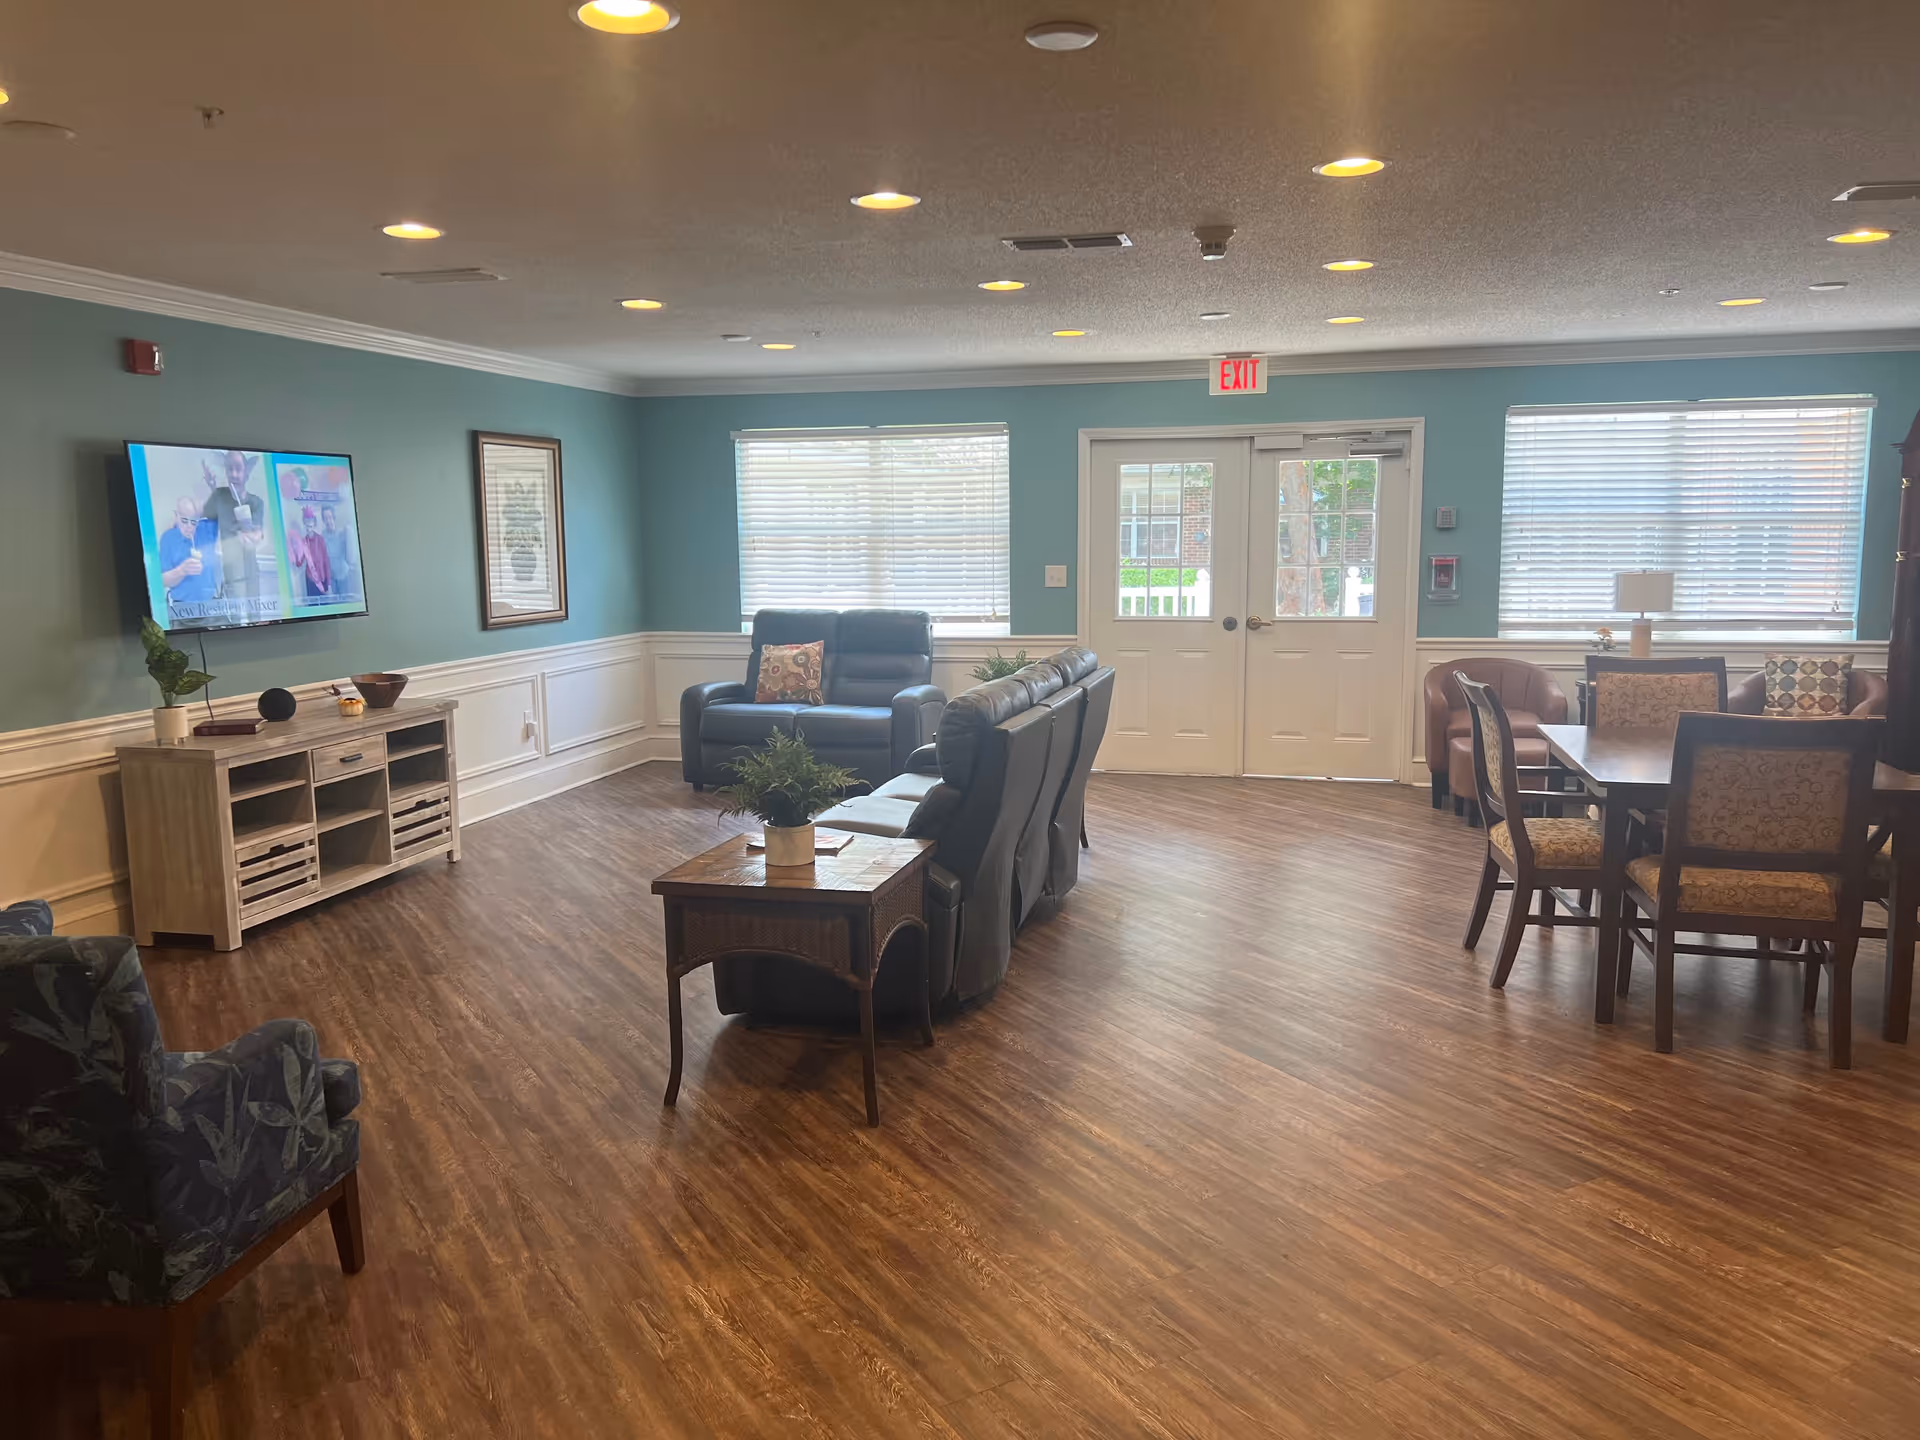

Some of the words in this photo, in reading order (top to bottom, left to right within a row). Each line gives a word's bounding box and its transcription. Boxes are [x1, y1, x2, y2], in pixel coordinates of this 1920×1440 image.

[1220, 359, 1260, 390] EXIT
[170, 605, 195, 617] New
[248, 600, 278, 612] Mixer
